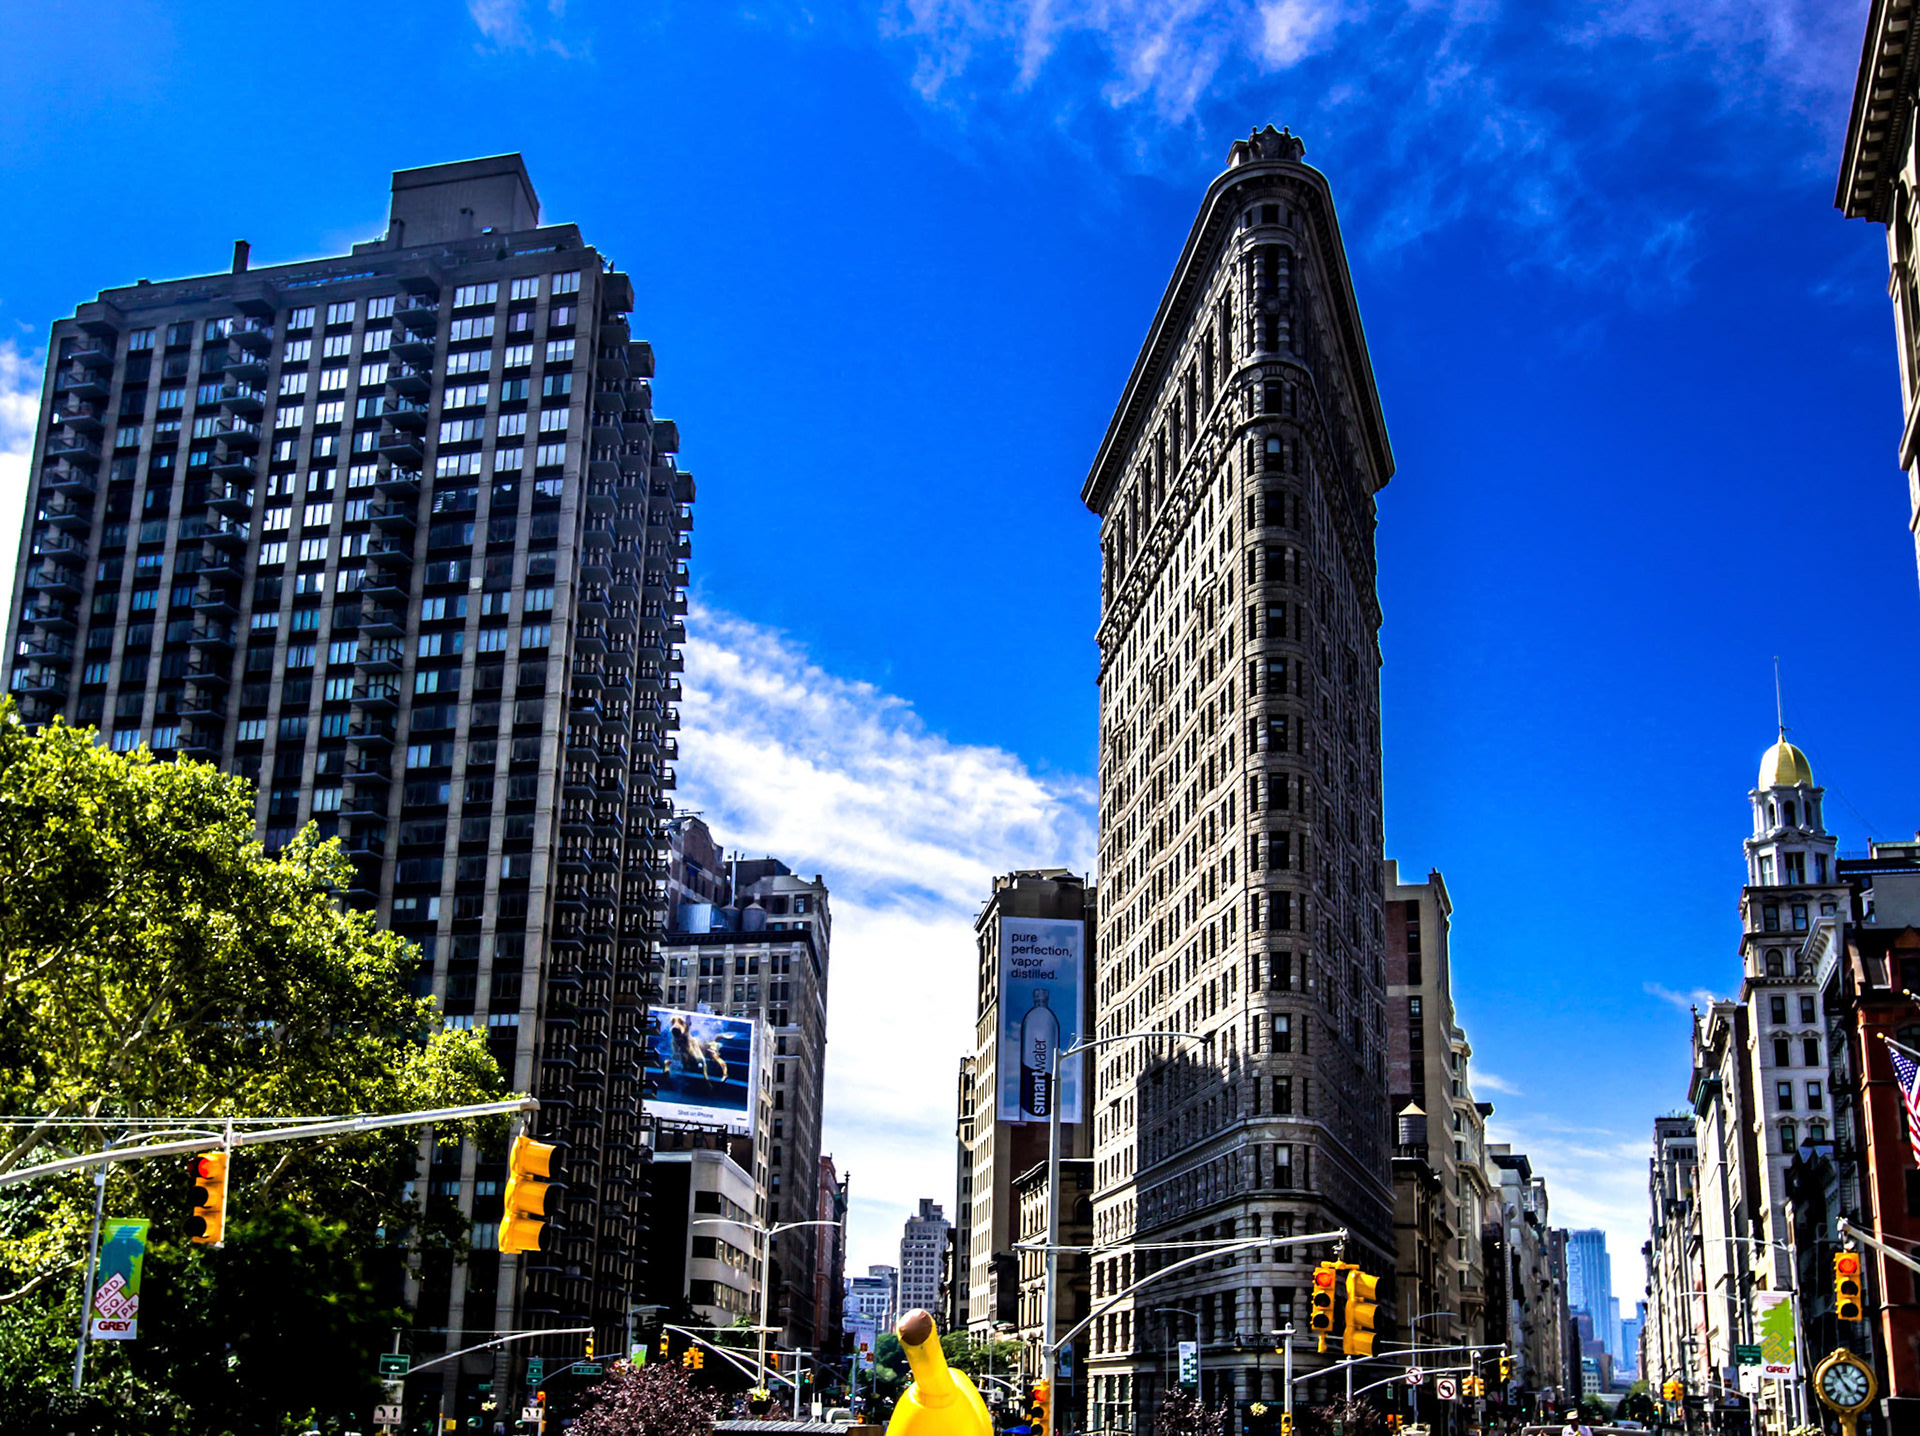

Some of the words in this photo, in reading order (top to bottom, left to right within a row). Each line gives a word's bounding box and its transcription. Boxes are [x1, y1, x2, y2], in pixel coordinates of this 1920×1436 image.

[1012, 933, 1038, 944] pure
[1011, 945, 1073, 959] perfection,
[1011, 958, 1044, 968] vapor
[1010, 968, 1058, 980] distilled.
[1031, 1037, 1047, 1114] smartwater
[96, 1280, 122, 1303] MAD.
[103, 1298, 124, 1314] SQ.
[121, 1301, 137, 1317] PK
[98, 1320, 131, 1331] GREY
[1766, 1365, 1791, 1374] GREY
